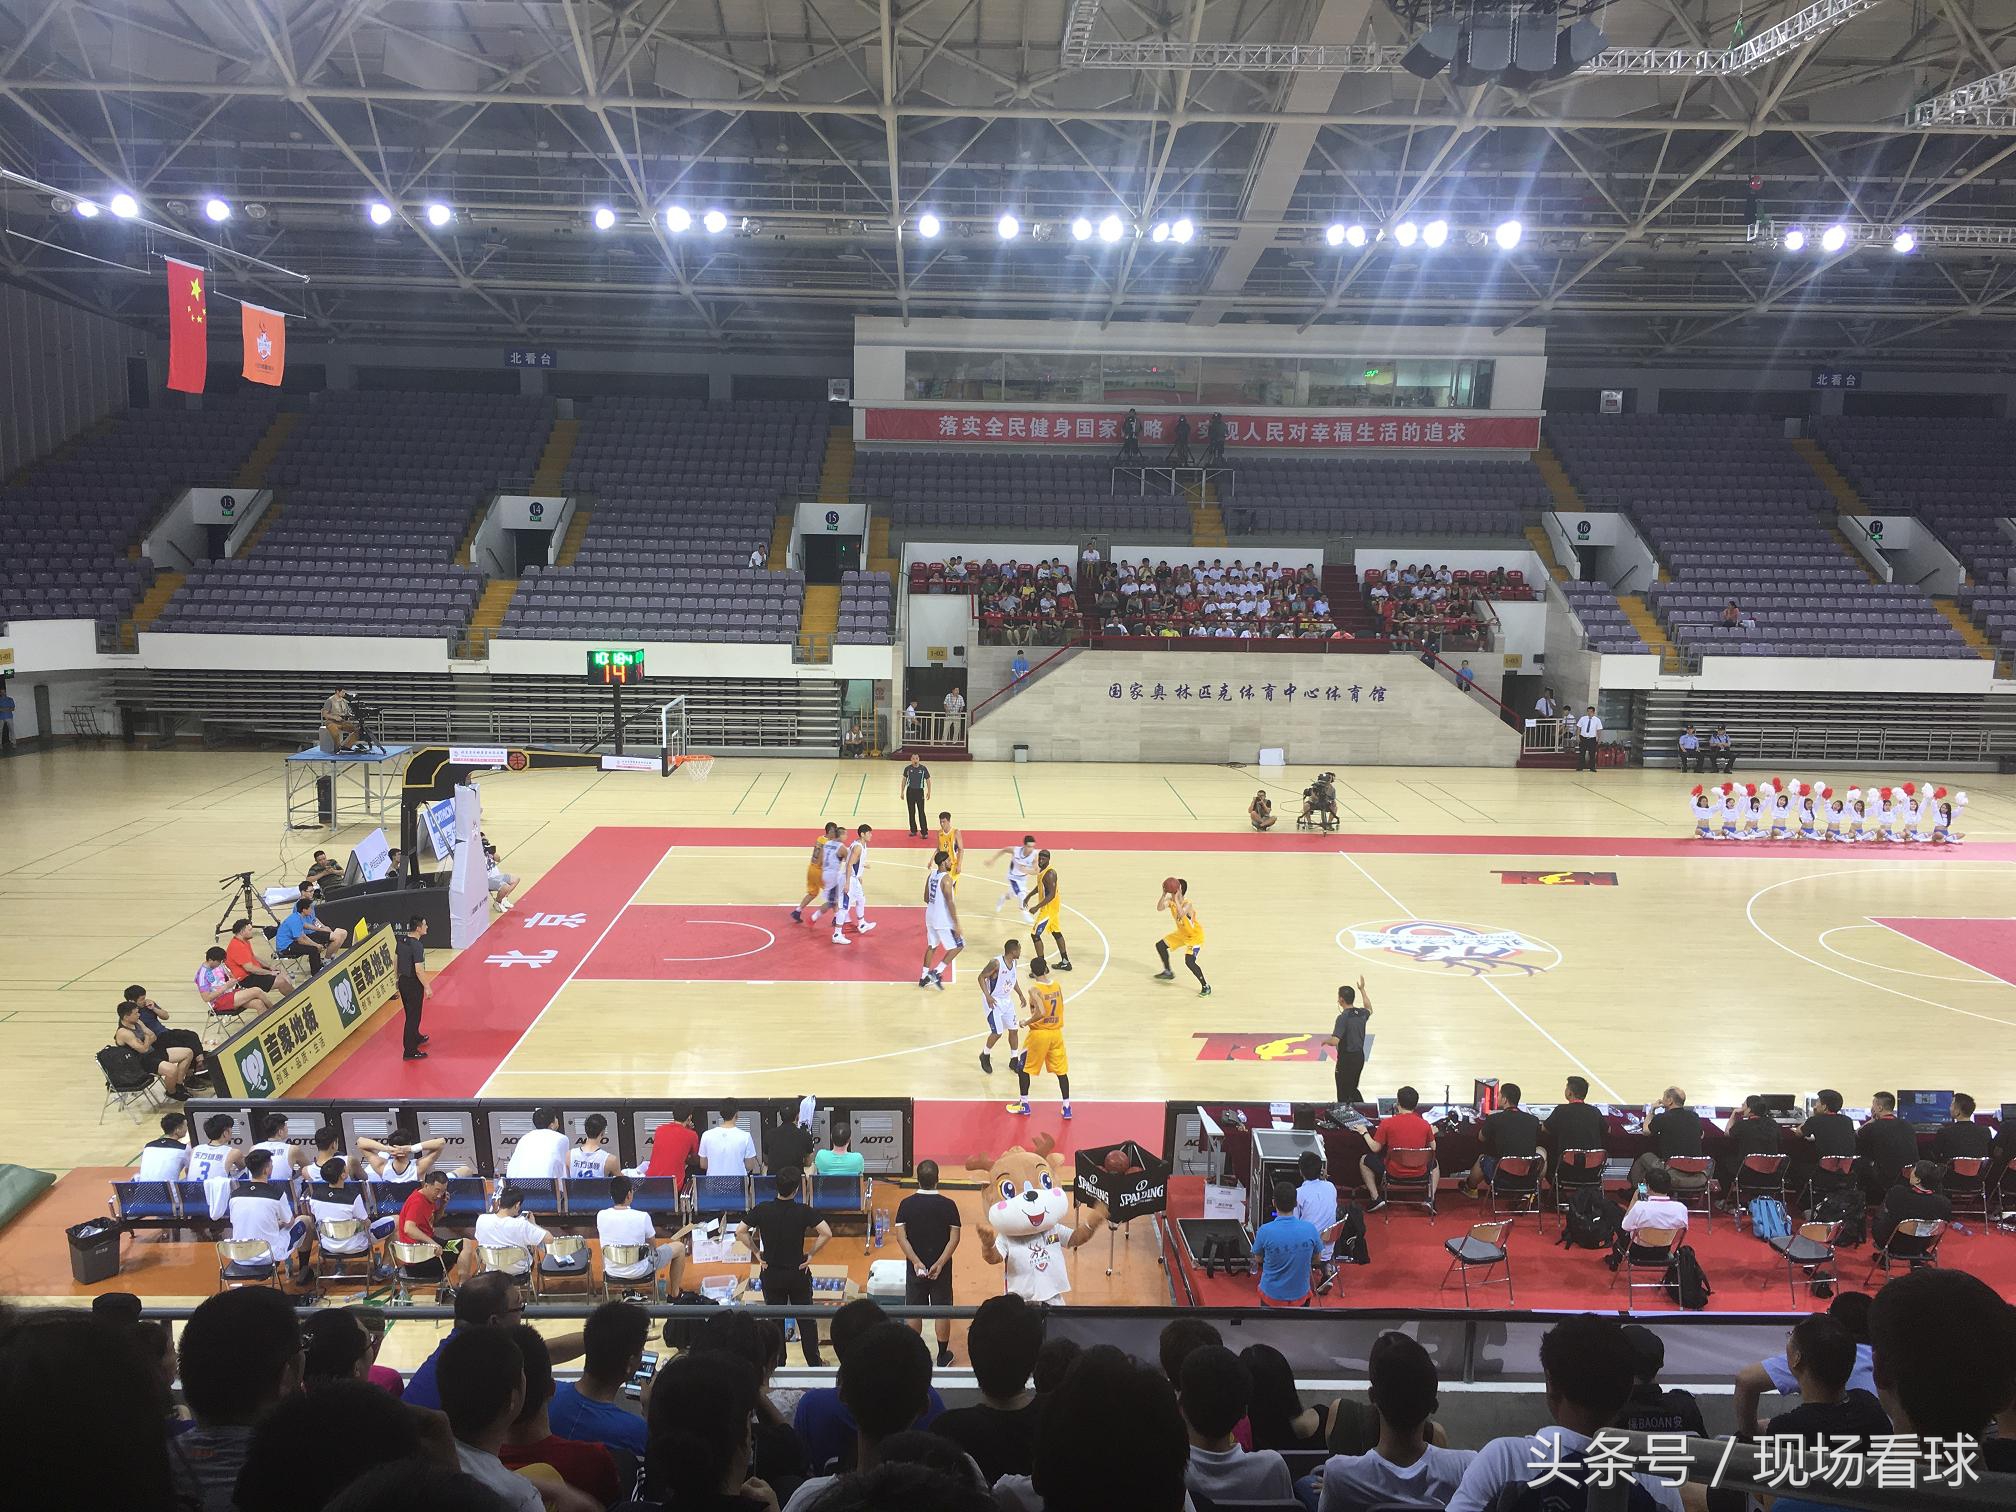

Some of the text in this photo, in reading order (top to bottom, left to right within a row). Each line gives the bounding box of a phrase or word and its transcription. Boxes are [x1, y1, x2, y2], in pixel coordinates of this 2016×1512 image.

[510, 351, 551, 365] 北看台
[1815, 373, 1856, 386] 北看台
[938, 415, 1164, 440] 落实全民健身国家略
[223, 498, 233, 507] 13
[532, 504, 541, 514] 14
[828, 513, 838, 523] 15
[1580, 523, 1589, 532] 16
[1872, 523, 1881, 532] 17
[605, 664, 626, 683] 14
[1108, 681, 1388, 703] 国家奥林匹克体育中心体育馆
[351, 942, 394, 995] 吉象地板
[1050, 999, 1057, 1017] 7
[263, 1002, 319, 1067] 吉象地板
[860, 1136, 894, 1144] AOTO
[198, 1161, 211, 1182] 3
[1078, 1175, 1109, 1206] SPALDING
[1119, 1184, 1164, 1207] SPALDING
